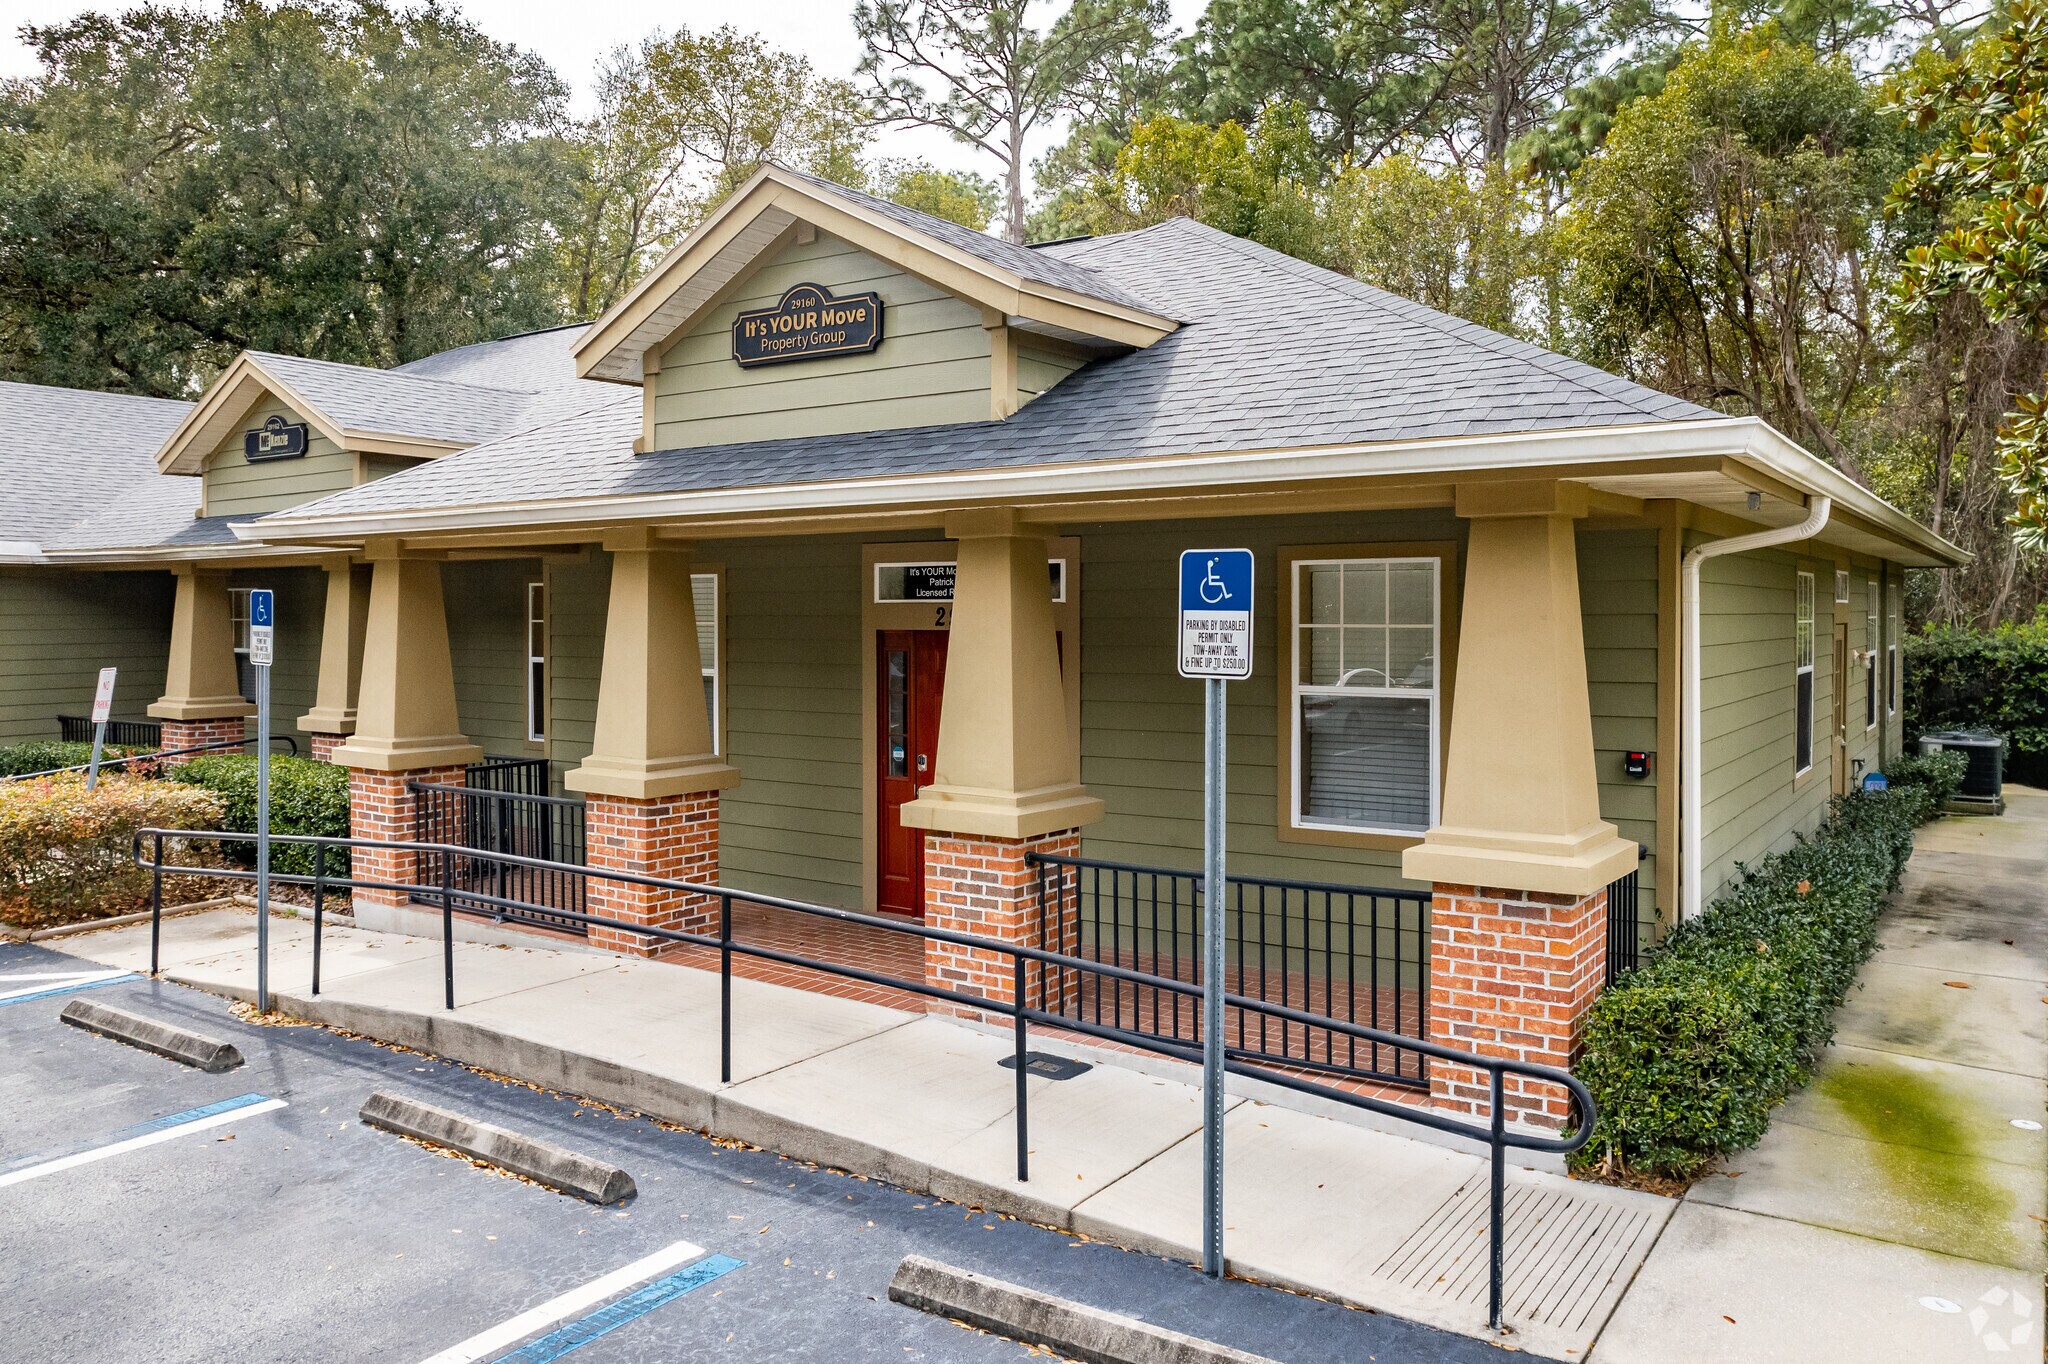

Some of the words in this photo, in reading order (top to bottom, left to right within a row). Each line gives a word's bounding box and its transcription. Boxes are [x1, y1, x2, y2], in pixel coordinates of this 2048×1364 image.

[791, 297, 816, 310] 29160
[745, 319, 767, 337] It's
[769, 311, 818, 334] YOUR
[821, 307, 866, 327] Move
[761, 334, 809, 352] Property
[810, 330, 846, 345] Group
[910, 567, 920, 576] It's
[921, 567, 945, 576] YOUR
[930, 578, 954, 586] Patrick
[916, 588, 948, 597] Licensed
[1185, 620, 1209, 631] PARKING
[1211, 620, 1218, 631] BY
[1219, 620, 1246, 631] DISABLED
[1198, 632, 1219, 643] PERMIT
[1220, 632, 1233, 644] ONLY
[1193, 644, 1222, 656] TOW-AWAY
[1224, 645, 1238, 656] ZONE
[1185, 657, 1190, 668] &
[1190, 657, 1203, 668] FINE
[1204, 657, 1212, 668] UP
[1213, 658, 1221, 668] TO
[1222, 658, 1246, 669] $250.00
